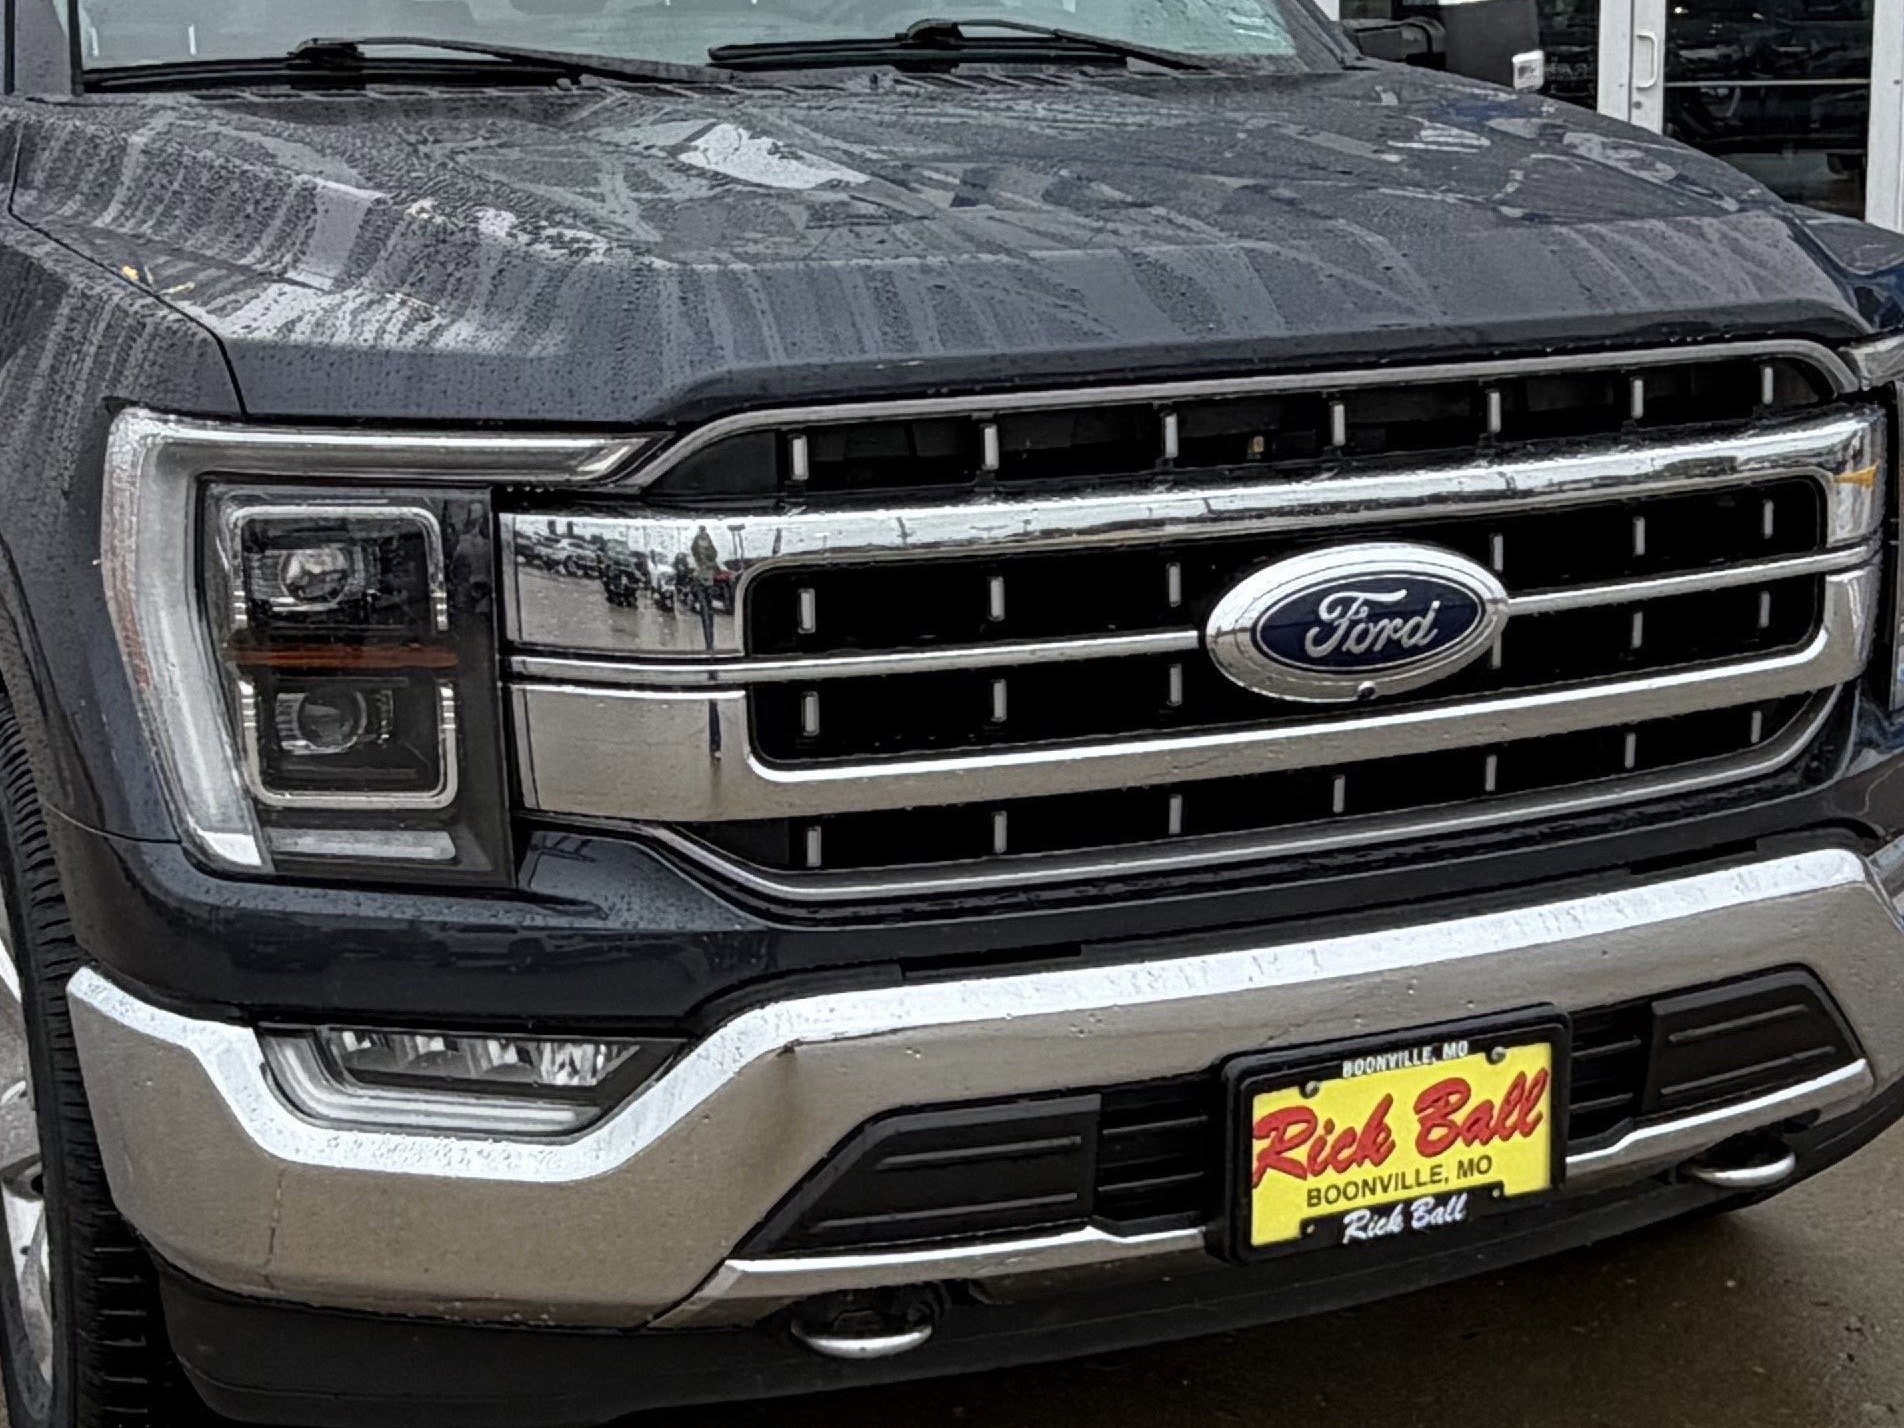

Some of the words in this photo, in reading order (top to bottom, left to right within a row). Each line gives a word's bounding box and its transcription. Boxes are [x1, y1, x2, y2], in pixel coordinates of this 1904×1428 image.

[1304, 589, 1442, 659] Ford
[1341, 1047, 1437, 1079] BOONVILLE,
[1441, 1040, 1469, 1061] MO
[1252, 1093, 1396, 1190] Rick
[1414, 1067, 1550, 1158] Ball
[1306, 1165, 1450, 1209] BOONVILLE,
[1456, 1154, 1493, 1180] MO
[1342, 1202, 1405, 1245] Rick
[1410, 1194, 1469, 1229] Ball
